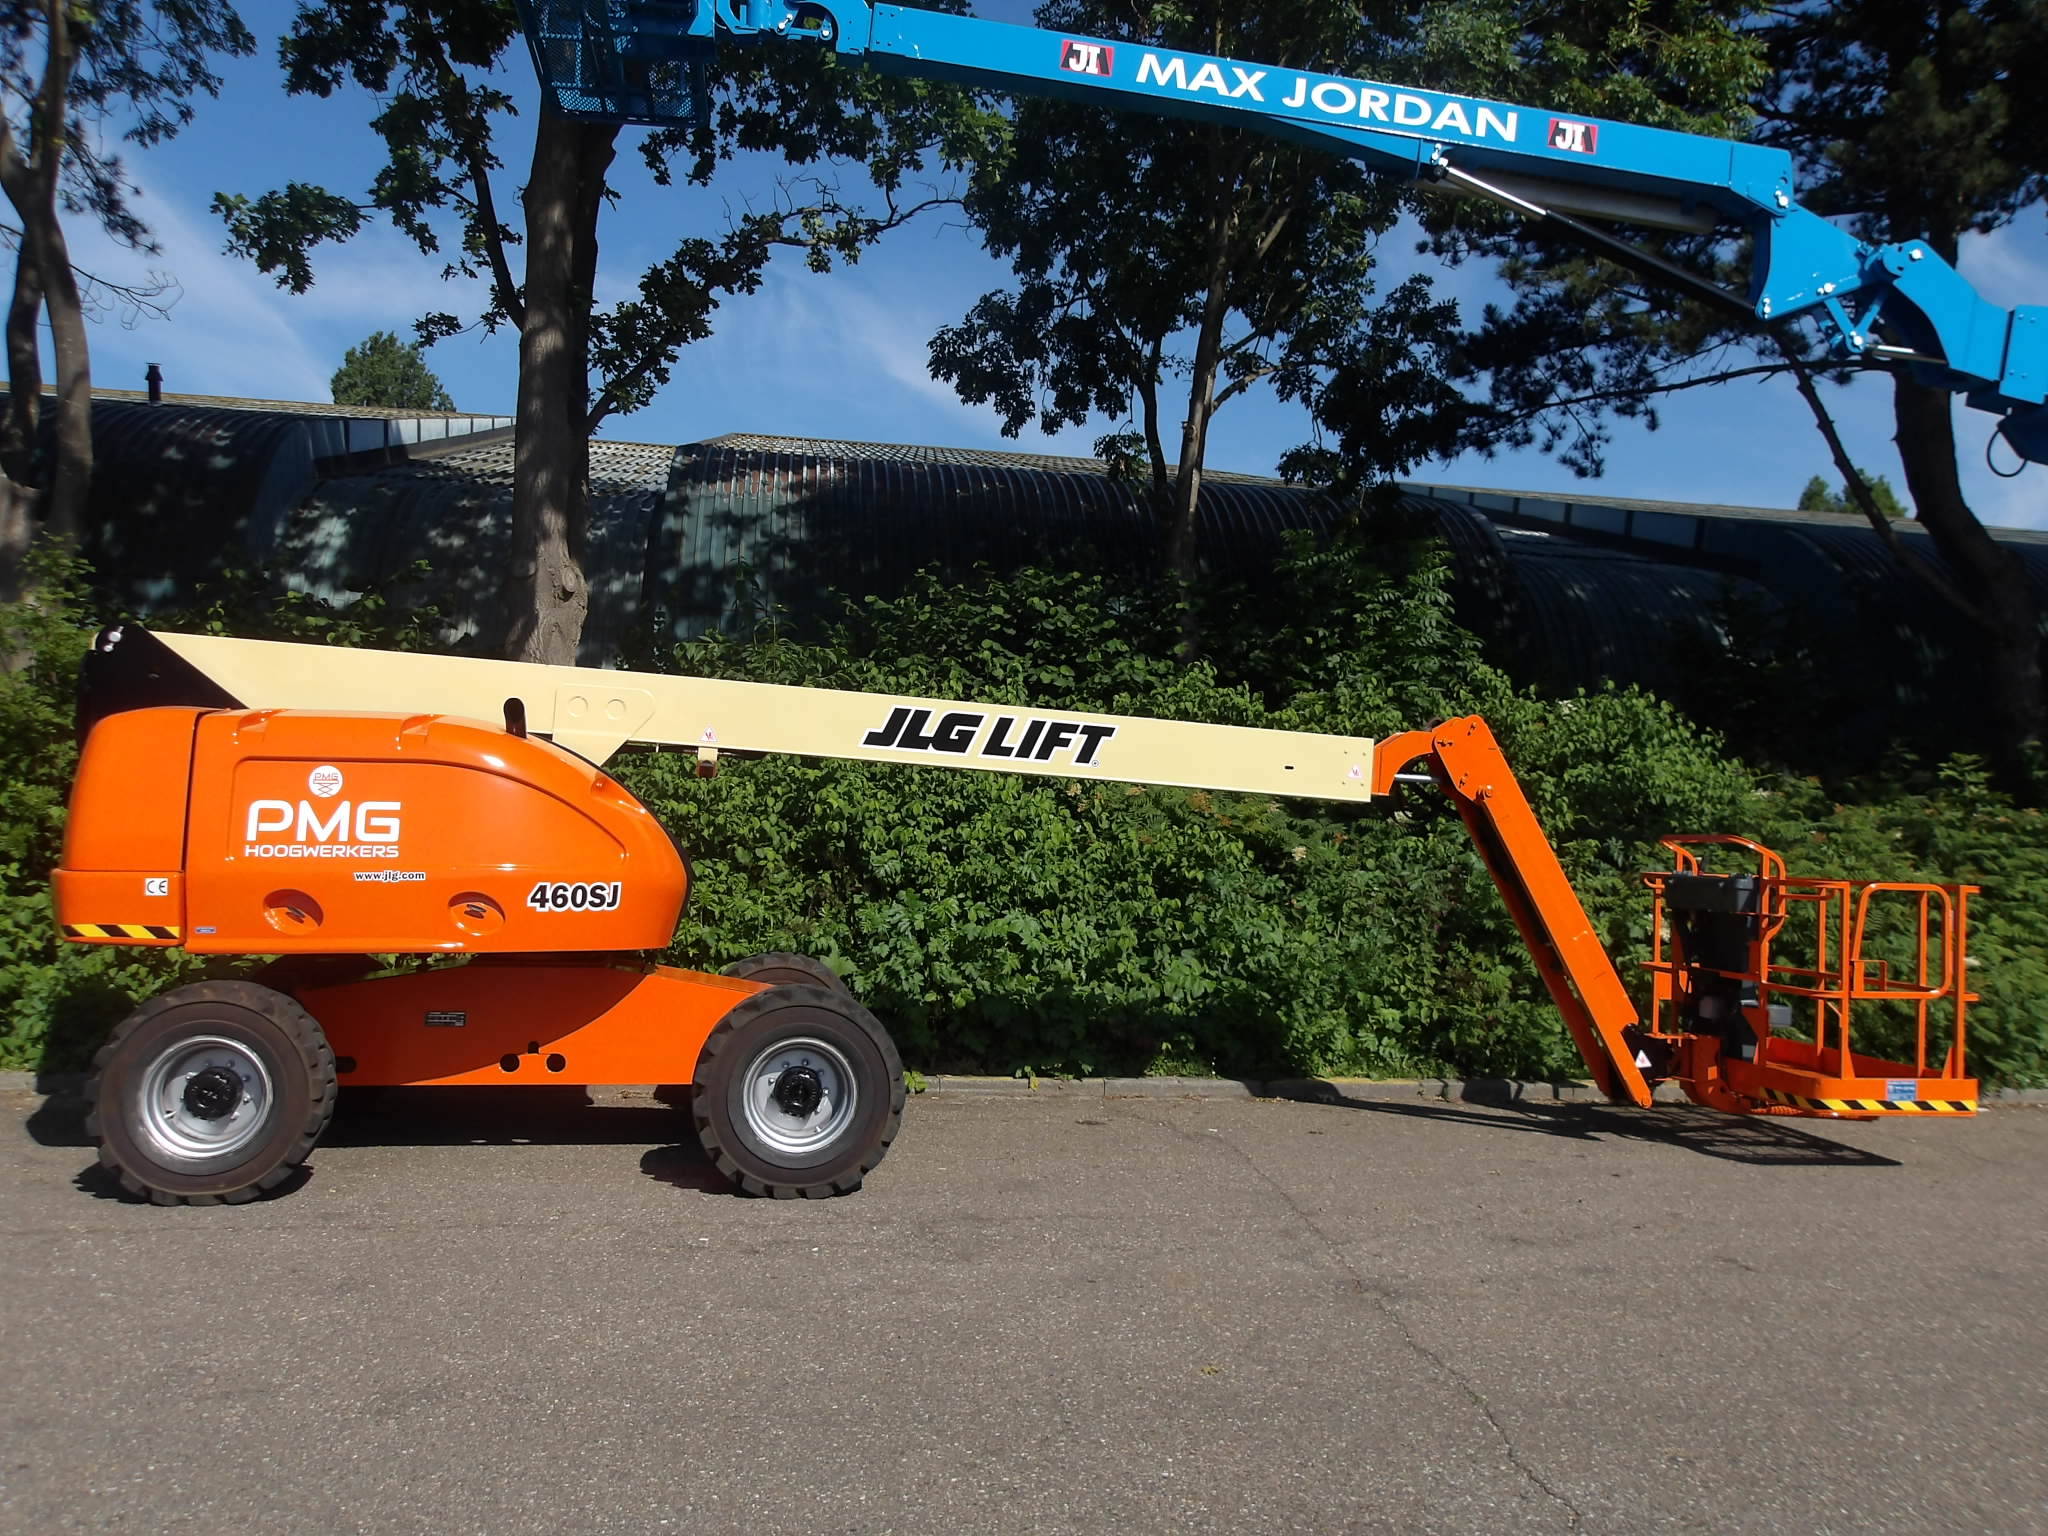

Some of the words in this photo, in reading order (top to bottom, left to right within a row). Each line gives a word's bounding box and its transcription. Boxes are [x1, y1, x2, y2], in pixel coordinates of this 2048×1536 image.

[1135, 53, 1267, 102] MAX
[1282, 78, 1518, 142] JORDAN
[862, 707, 985, 754] JLG
[982, 717, 1116, 764] LIFT
[313, 772, 339, 781] PMG
[246, 800, 401, 842] PMG
[245, 845, 399, 858] HOOGWERKERS
[355, 871, 425, 881] www.jlg.com
[147, 880, 167, 894] CE
[530, 884, 619, 908] 460SJ
